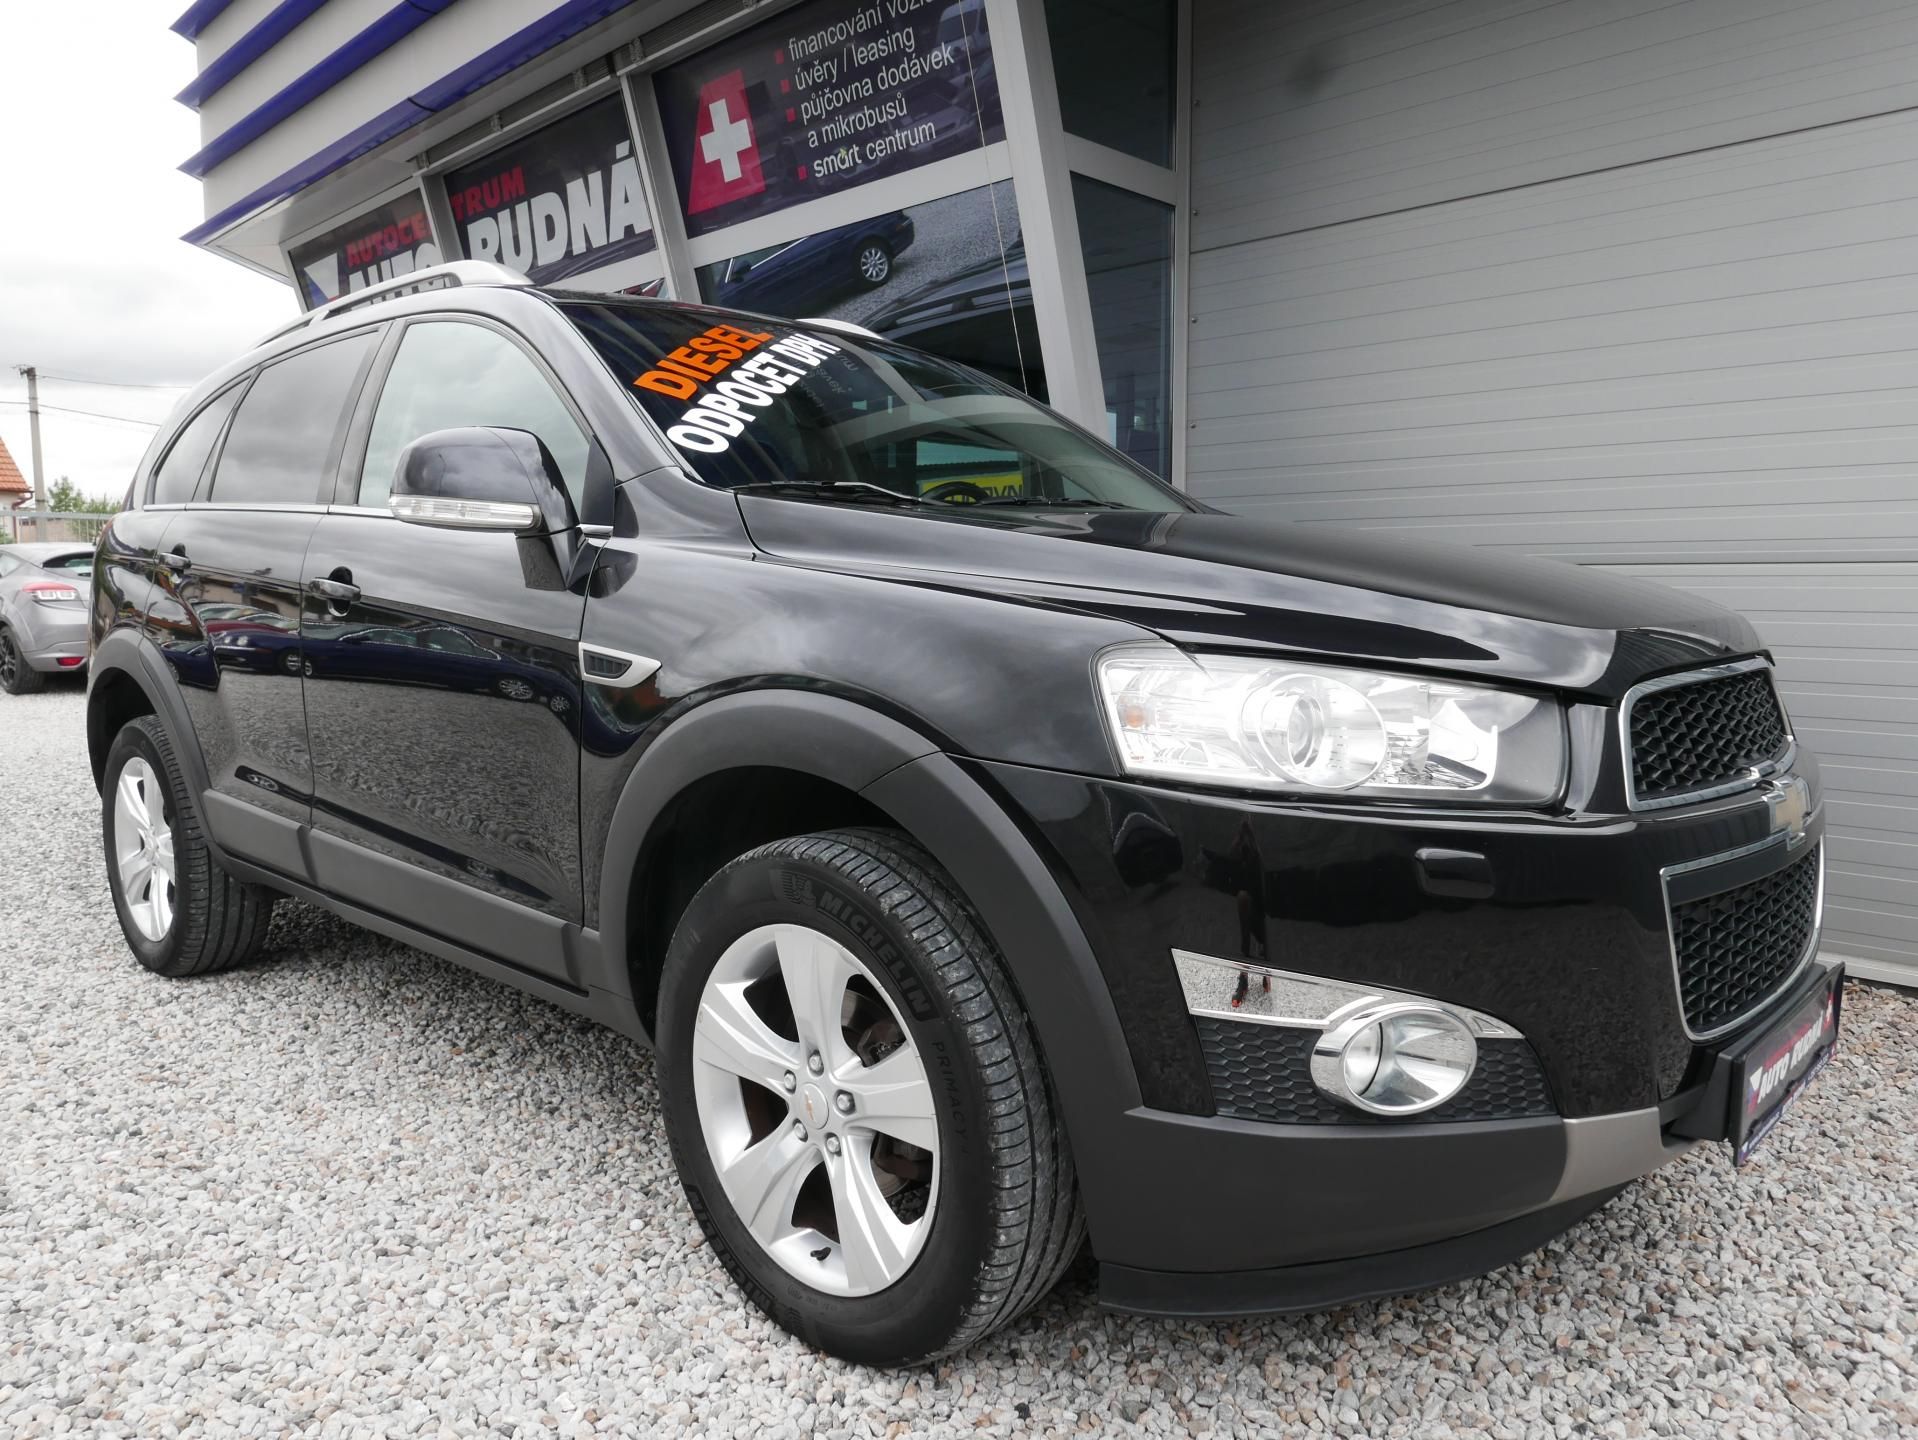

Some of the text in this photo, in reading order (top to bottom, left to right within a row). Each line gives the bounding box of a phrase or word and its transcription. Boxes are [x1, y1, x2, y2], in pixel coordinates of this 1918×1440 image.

[788, 0, 883, 61] financování
[795, 61, 838, 91] úvěry
[852, 27, 915, 68] leasing
[800, 42, 955, 125] půjčovna dodávek
[808, 92, 907, 148] a mikrobusů
[813, 121, 936, 178] smart centrum
[346, 211, 432, 268] AUTOCE
[467, 140, 652, 275] RUDNÁ
[633, 324, 775, 400] DIESEL
[666, 351, 808, 453] ODPOCET
[769, 333, 842, 369] DPH
[819, 890, 931, 1015] MICHELIN
[932, 1039, 969, 1139] PRIMACY
